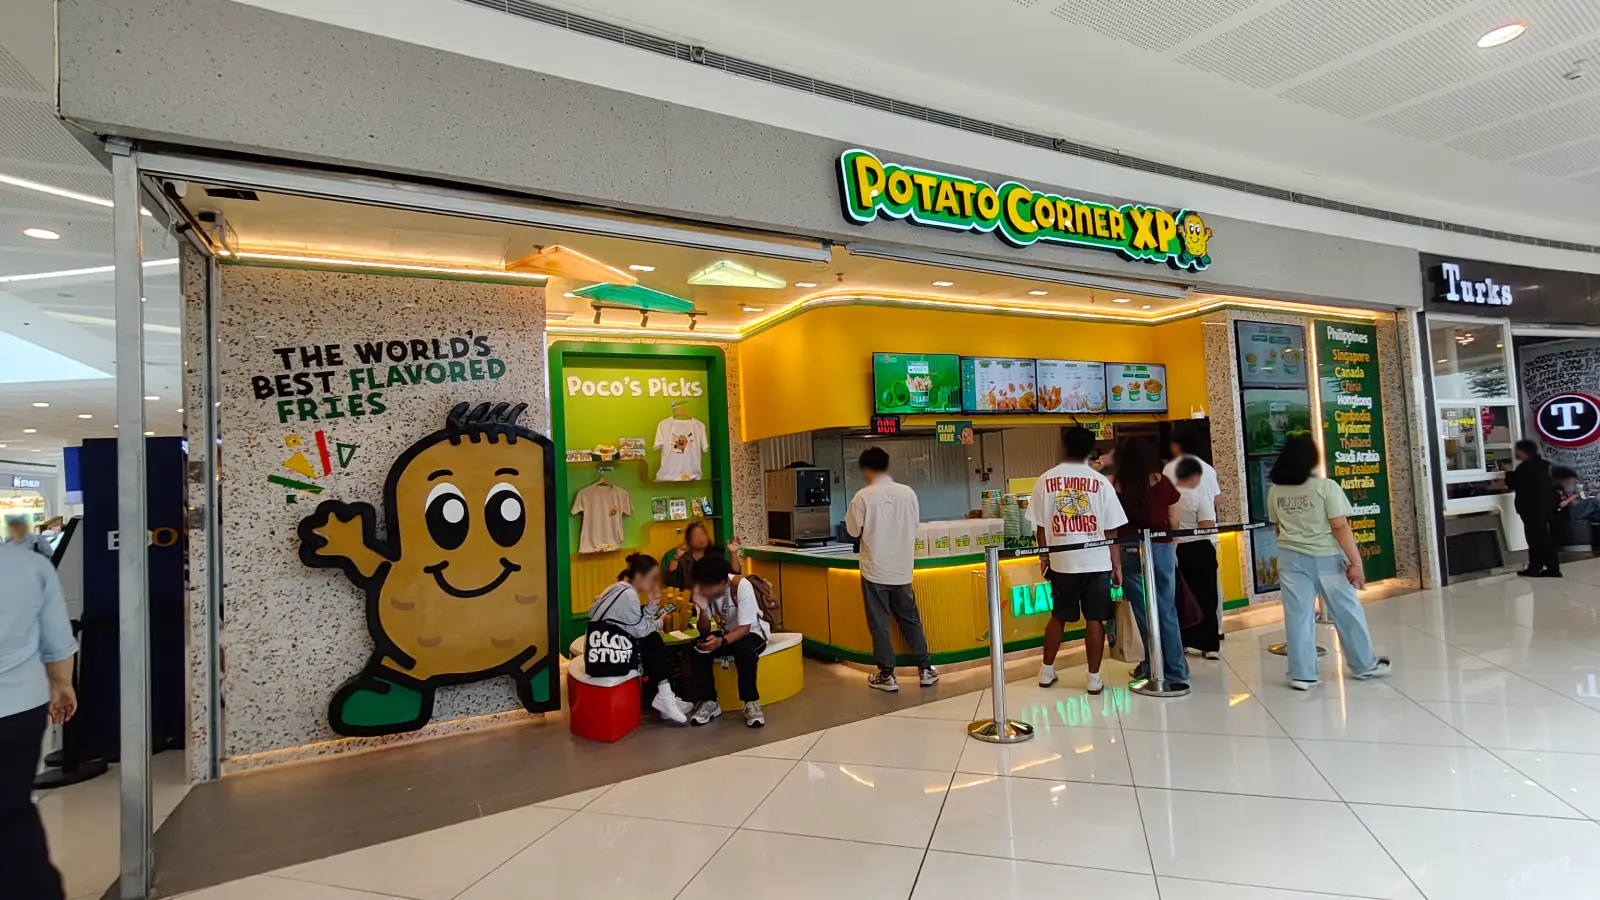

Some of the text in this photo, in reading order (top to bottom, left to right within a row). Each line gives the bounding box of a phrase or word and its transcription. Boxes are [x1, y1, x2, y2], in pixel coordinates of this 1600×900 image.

[855, 155, 999, 219] POTATO
[1130, 208, 1177, 252] XP
[1442, 262, 1513, 305] Turks
[1326, 325, 1368, 344] Philippines
[272, 330, 492, 370] THE WORLD'S
[1332, 348, 1370, 364] Singapore
[251, 358, 506, 400] BEST FLAVORED
[1334, 366, 1365, 378] Canada
[566, 376, 703, 397] Poco's Picks
[1340, 380, 1362, 391] China
[276, 391, 387, 424] FRIES
[1336, 393, 1372, 409] Hongkong
[1334, 409, 1371, 421] Cambodia
[1550, 402, 1584, 431] T
[937, 424, 956, 433] CLAIM
[1337, 422, 1371, 437] Myanmar
[939, 433, 955, 442] HERE
[1340, 436, 1372, 449] Thailand
[1335, 449, 1380, 463] Saudi Arabia
[1352, 463, 1380, 475] Zealand
[1045, 477, 1099, 493] THE WORLD
[1341, 475, 1375, 489] Australia
[1061, 514, 1097, 533] YOURS
